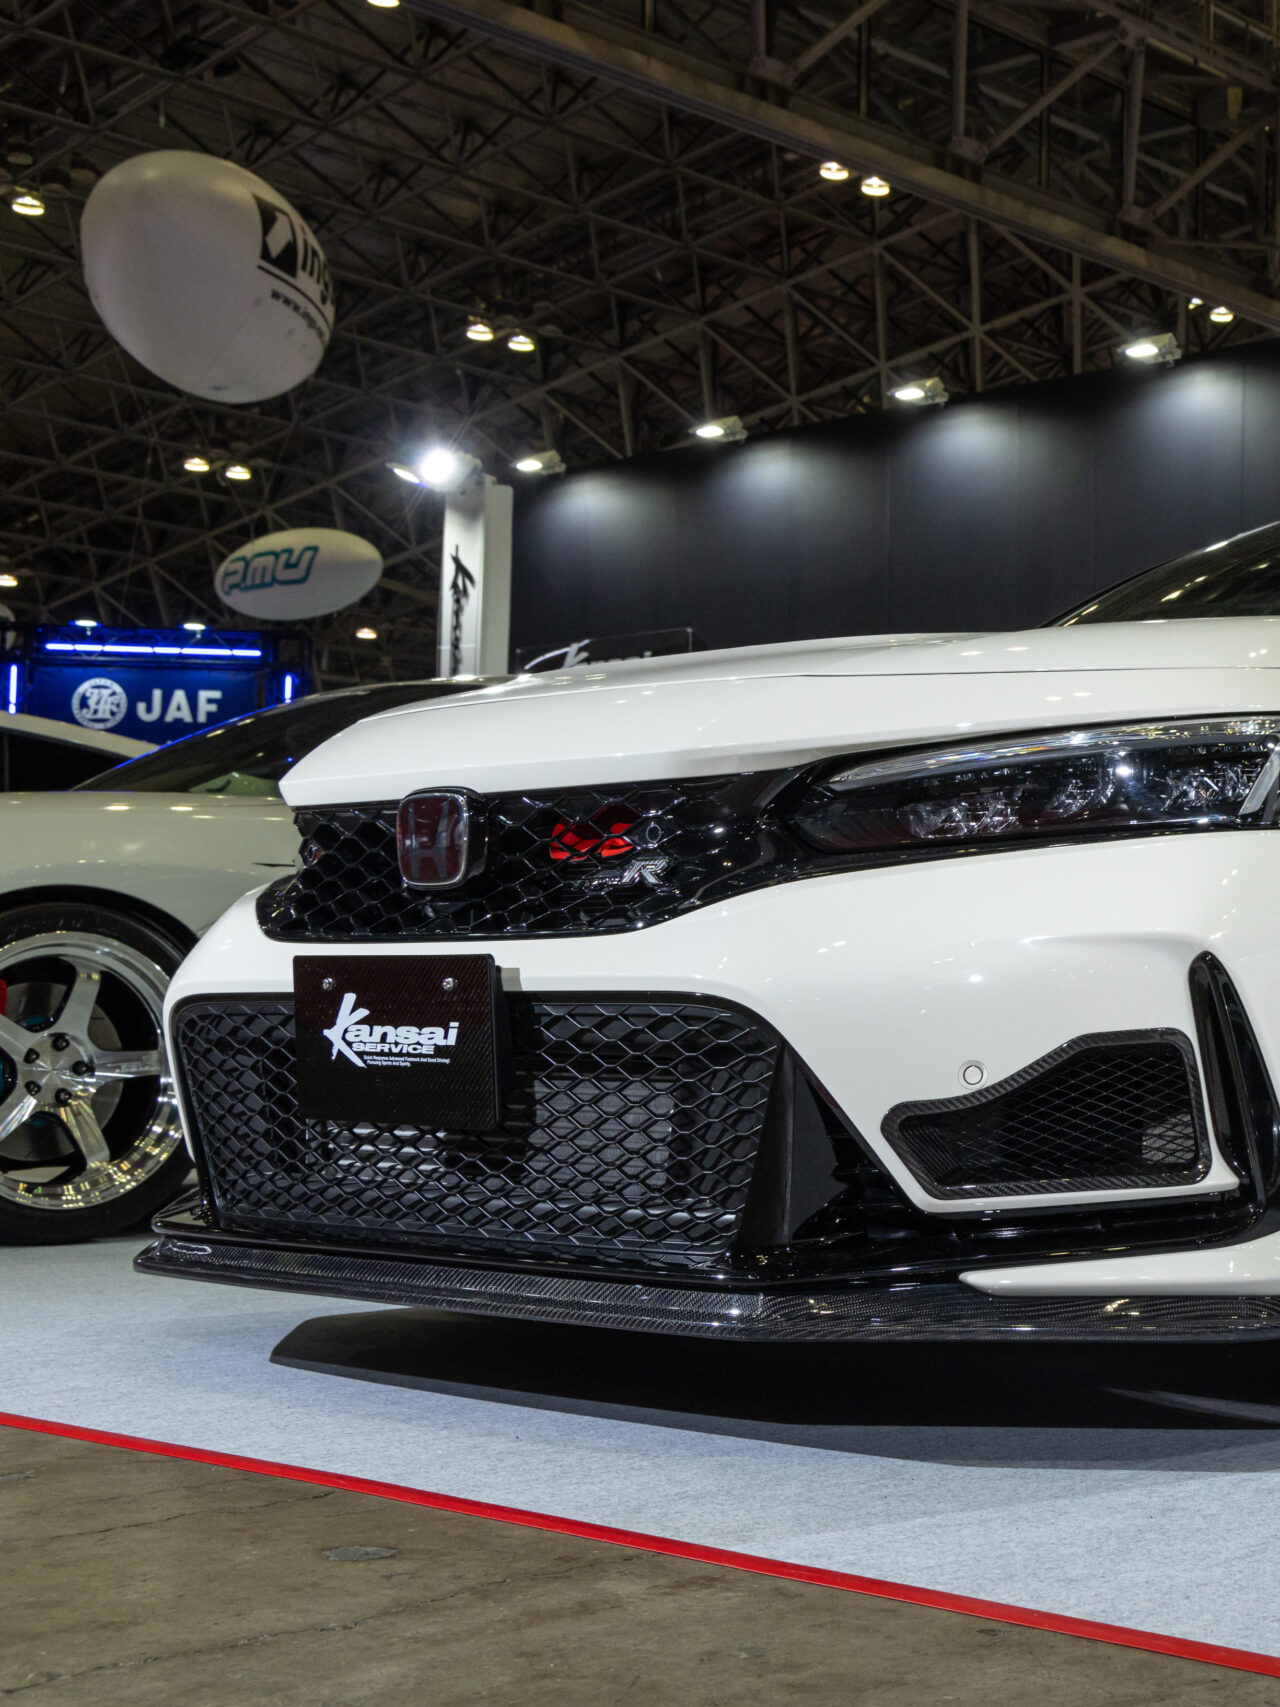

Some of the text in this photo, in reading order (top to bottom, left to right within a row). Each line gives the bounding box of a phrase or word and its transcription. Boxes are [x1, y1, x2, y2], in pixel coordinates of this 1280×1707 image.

[136, 688, 224, 724] JAF
[322, 992, 460, 1069] Kansai
[351, 1042, 436, 1055] SERVICE
